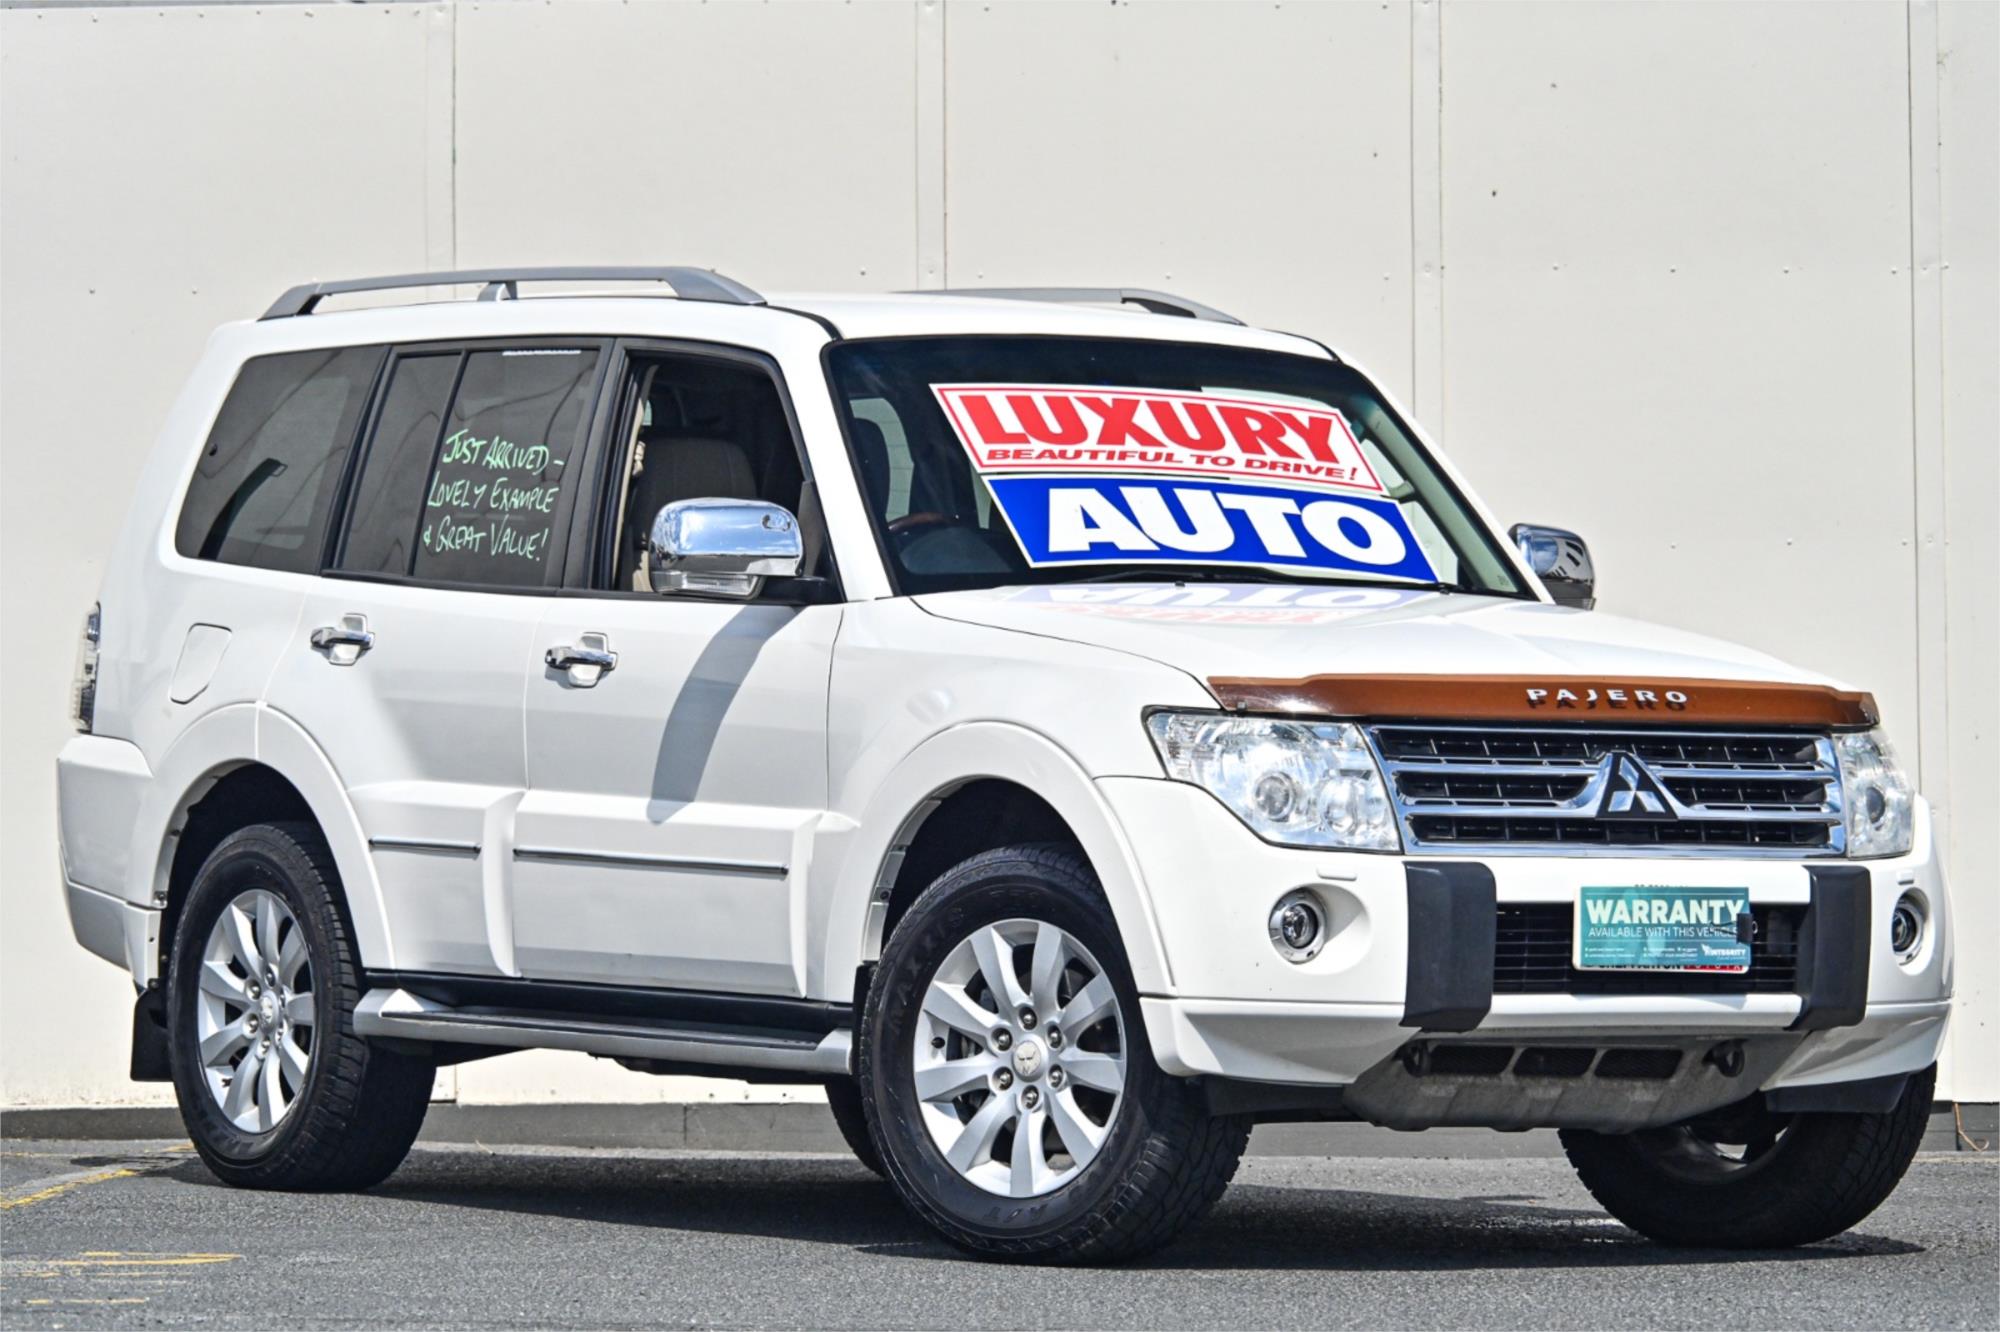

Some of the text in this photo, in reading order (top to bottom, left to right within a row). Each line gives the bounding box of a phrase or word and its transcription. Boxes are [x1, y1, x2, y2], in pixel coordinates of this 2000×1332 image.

[958, 394, 1339, 464] LUXURY
[986, 448, 1359, 481] BEAUTIFUL TO DRIVE!
[427, 470, 559, 513] LOVELY EXAMPLE
[435, 515, 487, 552] GREAT
[490, 514, 548, 561] VALUE!
[1048, 487, 1407, 566] AUTO
[1526, 689, 1688, 703] PAJERO
[1585, 898, 1745, 925] WARRANTY
[1588, 927, 1642, 937] AVAILABLE
[1645, 927, 1671, 937] WITH
[1673, 927, 1695, 937] THIS
